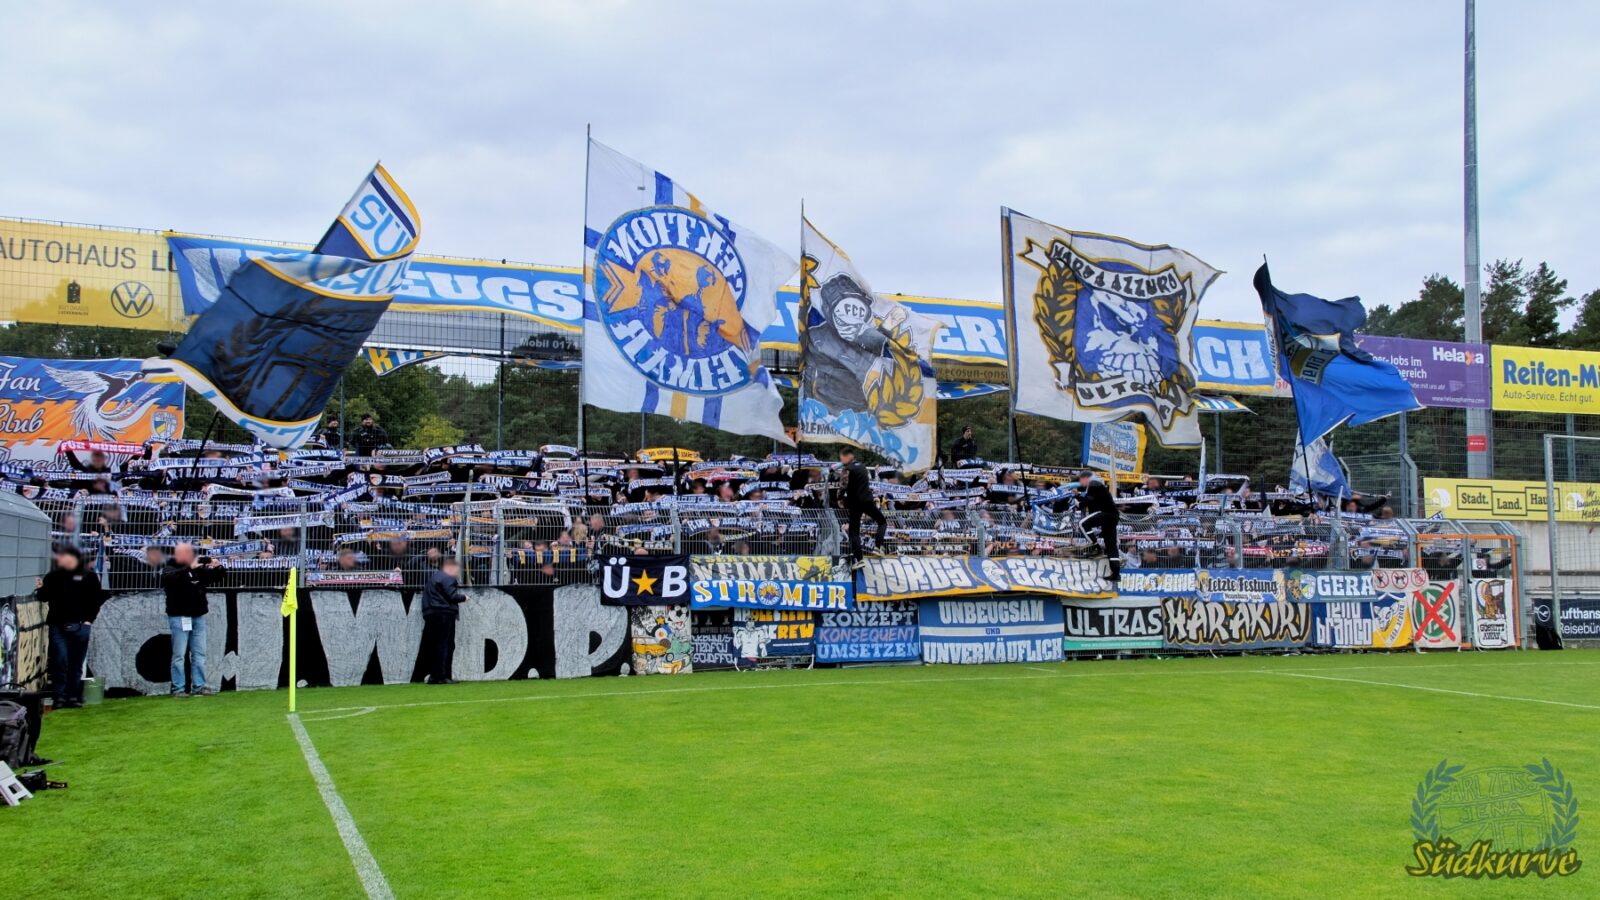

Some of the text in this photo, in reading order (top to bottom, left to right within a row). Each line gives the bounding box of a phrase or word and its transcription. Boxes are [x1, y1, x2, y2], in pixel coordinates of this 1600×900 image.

[844, 303, 866, 318] FCC
[521, 338, 549, 349] Mobil
[1503, 390, 1594, 404] Auto-Service. Echt gut.
[1461, 492, 1489, 505] Stadt.
[1497, 498, 1522, 510] Land.
[690, 561, 803, 581] WEIMAR
[1238, 576, 1278, 595] Festung
[1317, 575, 1376, 596] GERA
[821, 611, 915, 627] KONZEPT
[939, 600, 1045, 624] UNBEUGSAM
[1164, 598, 1309, 643] HARAKIRI
[1066, 607, 1163, 637] ULTRAS
[820, 627, 916, 644] KONSEQUENT
[816, 642, 919, 659] UMSETZEN
[923, 637, 1063, 665] UNVERKÄUFLICH
